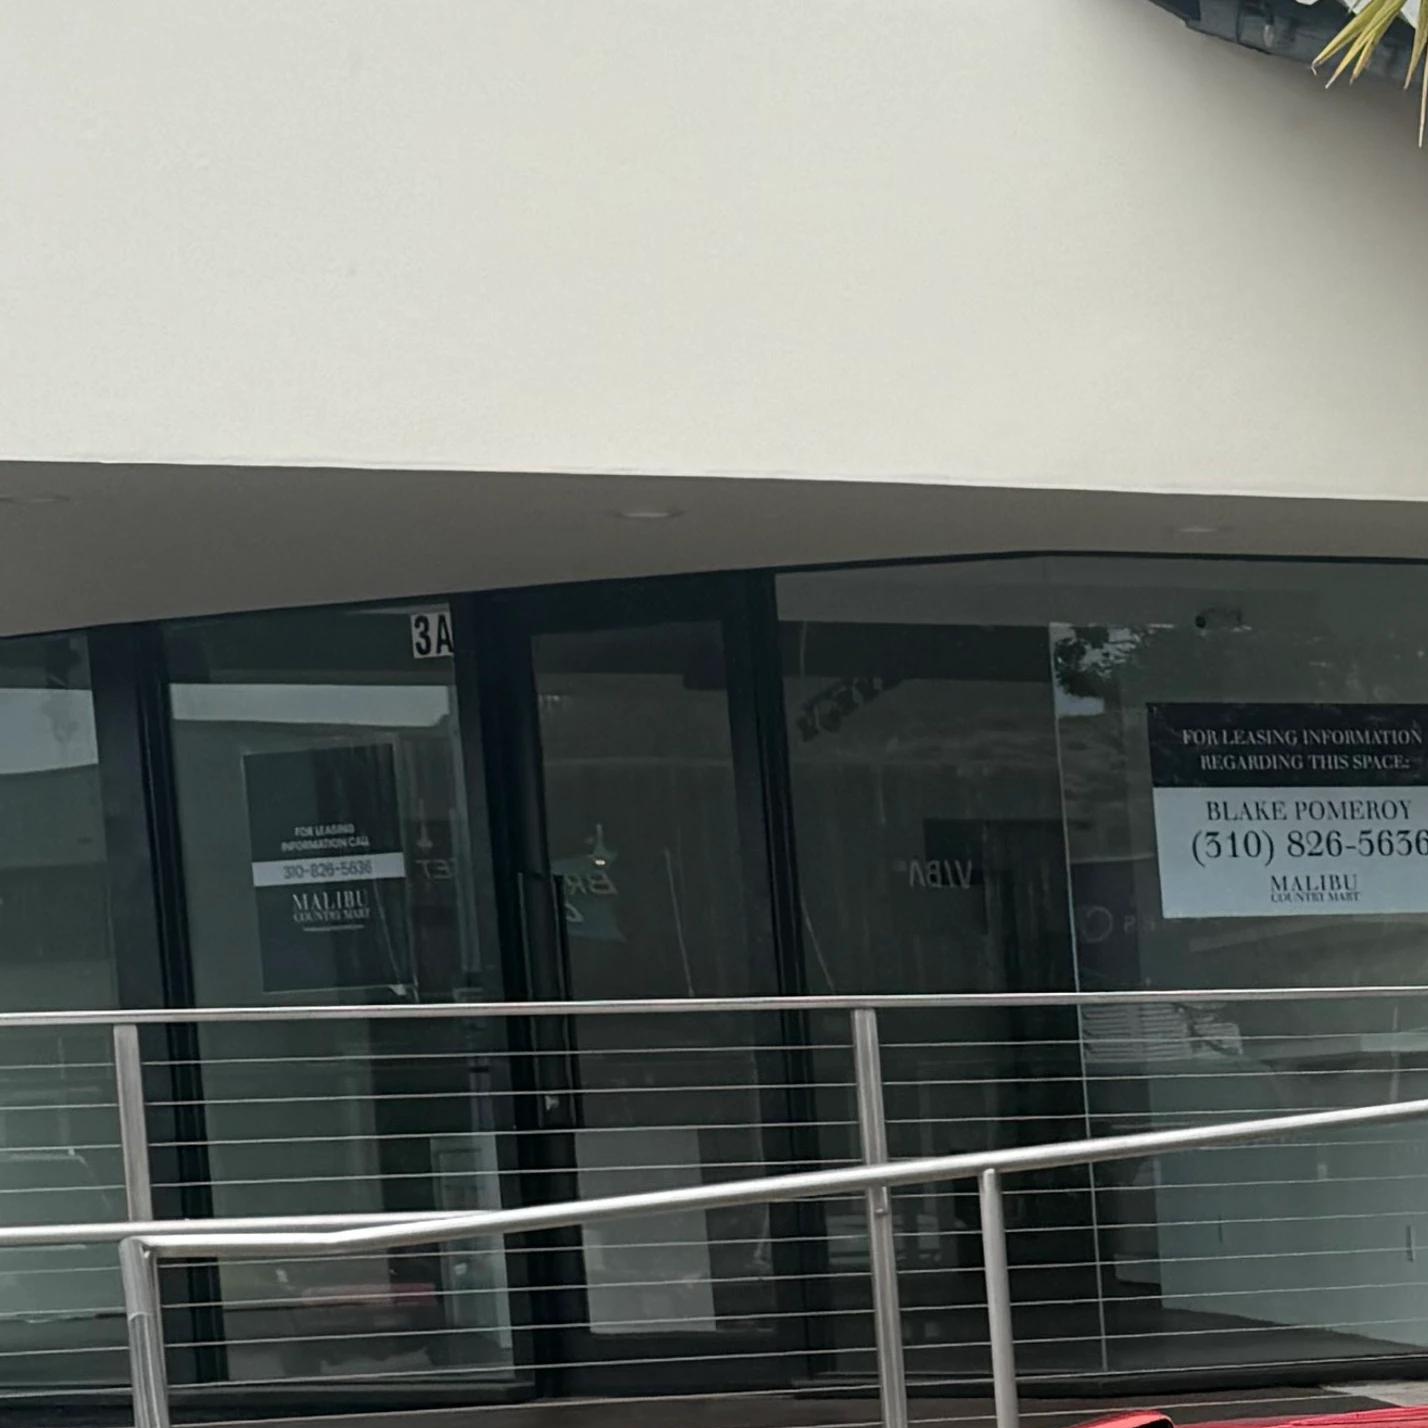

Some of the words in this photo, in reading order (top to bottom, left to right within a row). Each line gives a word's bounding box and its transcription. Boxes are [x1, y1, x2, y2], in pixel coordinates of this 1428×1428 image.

[414, 614, 453, 656] 3A
[1182, 729, 1220, 746] FOR
[1222, 729, 1298, 745] LEASING
[1302, 729, 1423, 745] INFORMATION
[1200, 755, 1304, 771] REGARDING
[1307, 755, 1349, 770] THIS
[1206, 800, 1287, 821] BLAKE
[1294, 799, 1413, 821] POMEROY
[294, 826, 314, 838] FOR
[315, 823, 355, 836] LEASING
[1191, 829, 1275, 867] (310)
[283, 860, 373, 880] 310-826-5636
[1270, 874, 1359, 891] MALIBU
[292, 888, 368, 910] MALIBU
